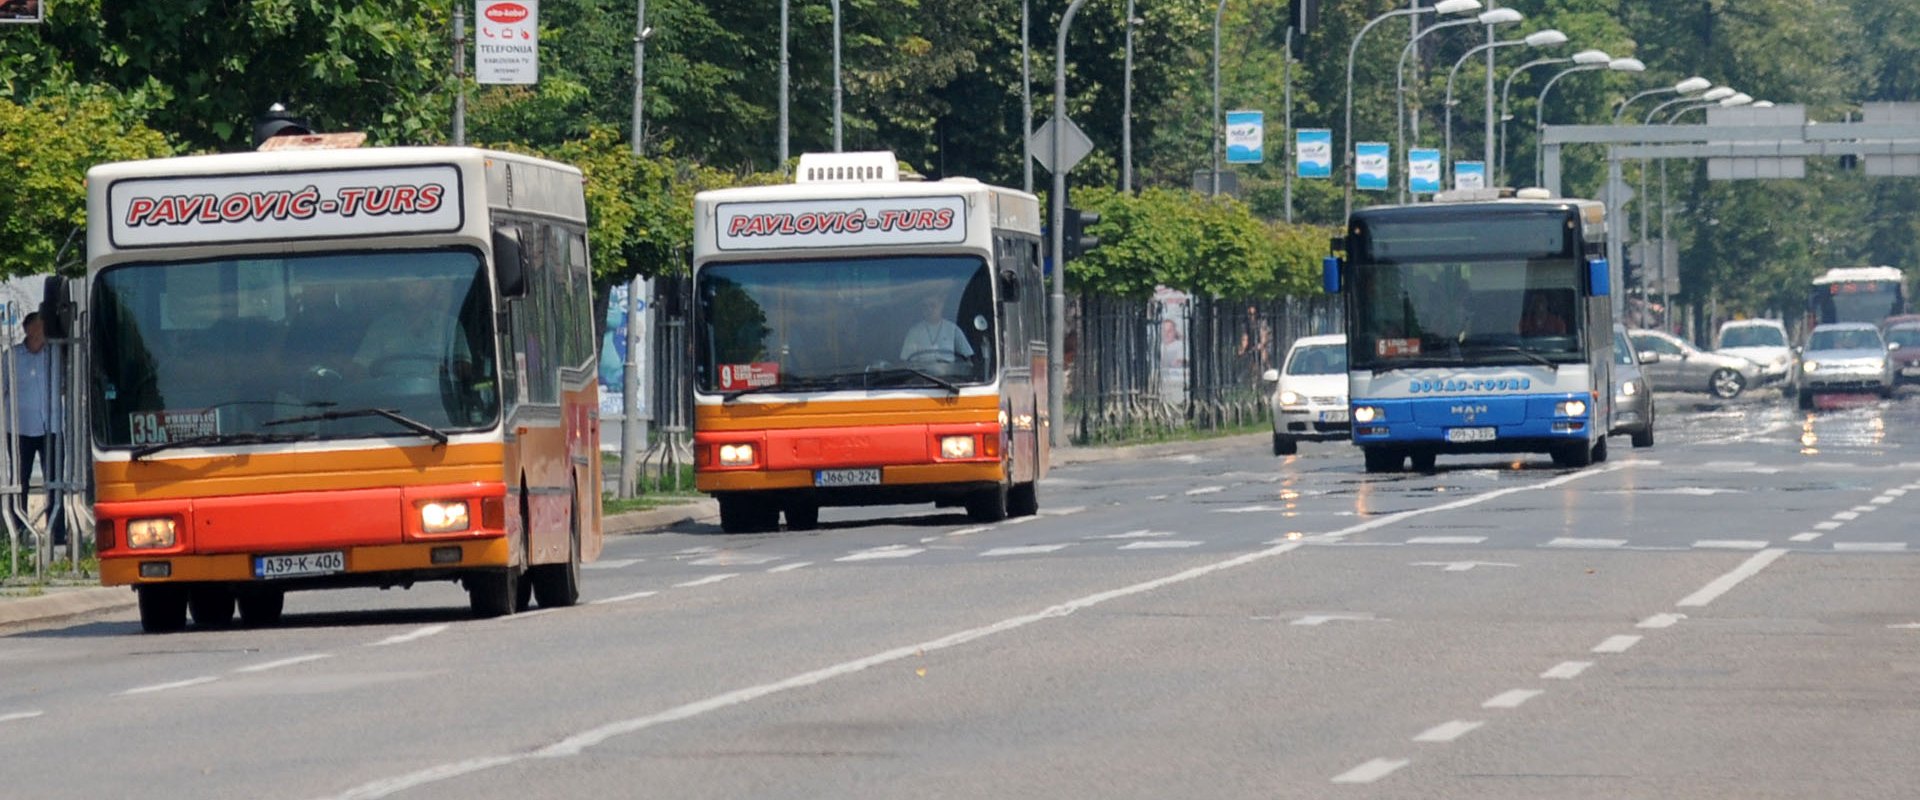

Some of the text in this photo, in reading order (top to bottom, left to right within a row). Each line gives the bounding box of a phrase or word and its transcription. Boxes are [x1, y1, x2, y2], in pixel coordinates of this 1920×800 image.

[480, 45, 532, 53] TELEFONIJA
[722, 365, 732, 388] 9
[1451, 405, 1488, 414] MAN
[265, 554, 342, 574] A39-K-406
